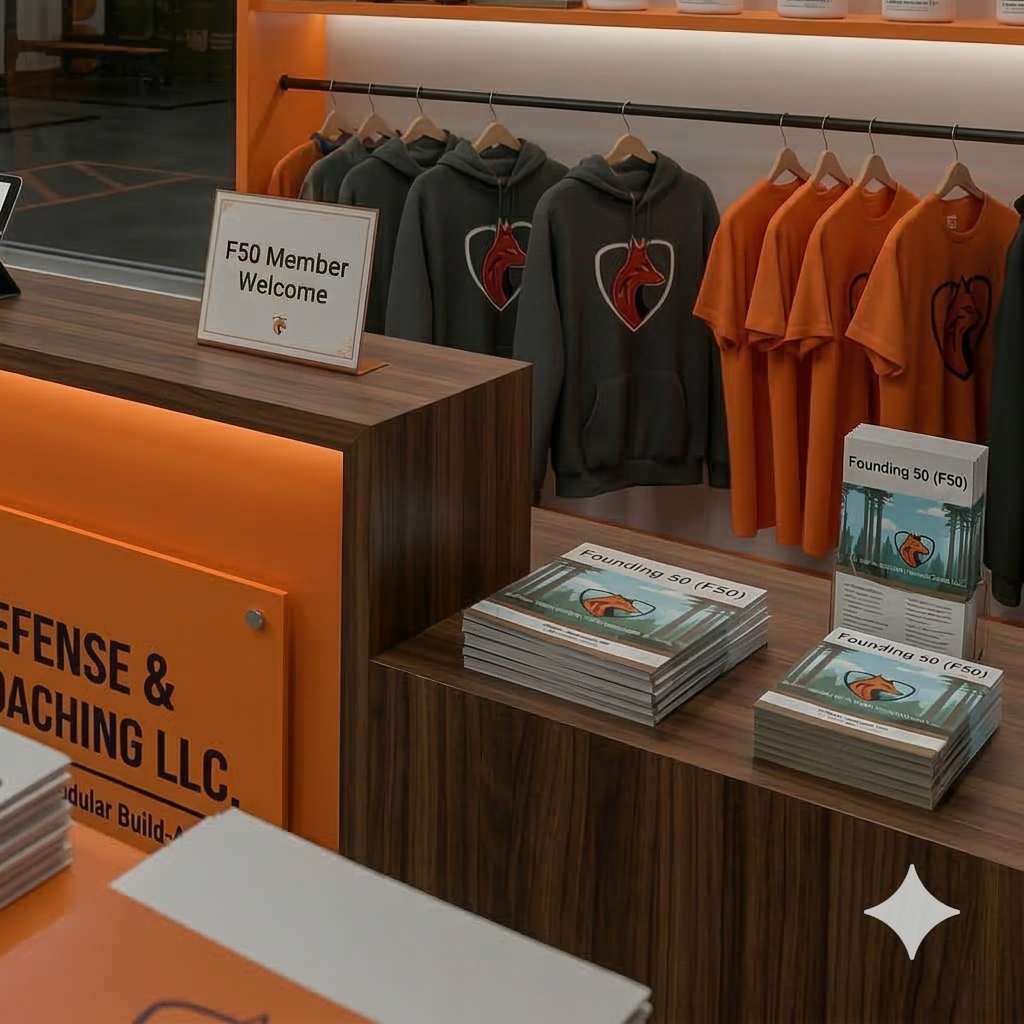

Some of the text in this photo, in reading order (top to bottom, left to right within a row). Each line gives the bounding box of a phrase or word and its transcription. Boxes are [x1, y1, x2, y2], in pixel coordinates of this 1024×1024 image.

[226, 240, 350, 277] F50 Member
[239, 270, 328, 304] Welcome
[848, 455, 968, 493] Founding 50 (F50)
[579, 549, 746, 600] Founding 50 (F50)
[143, 652, 175, 711] &
[157, 729, 240, 808] LLC.
